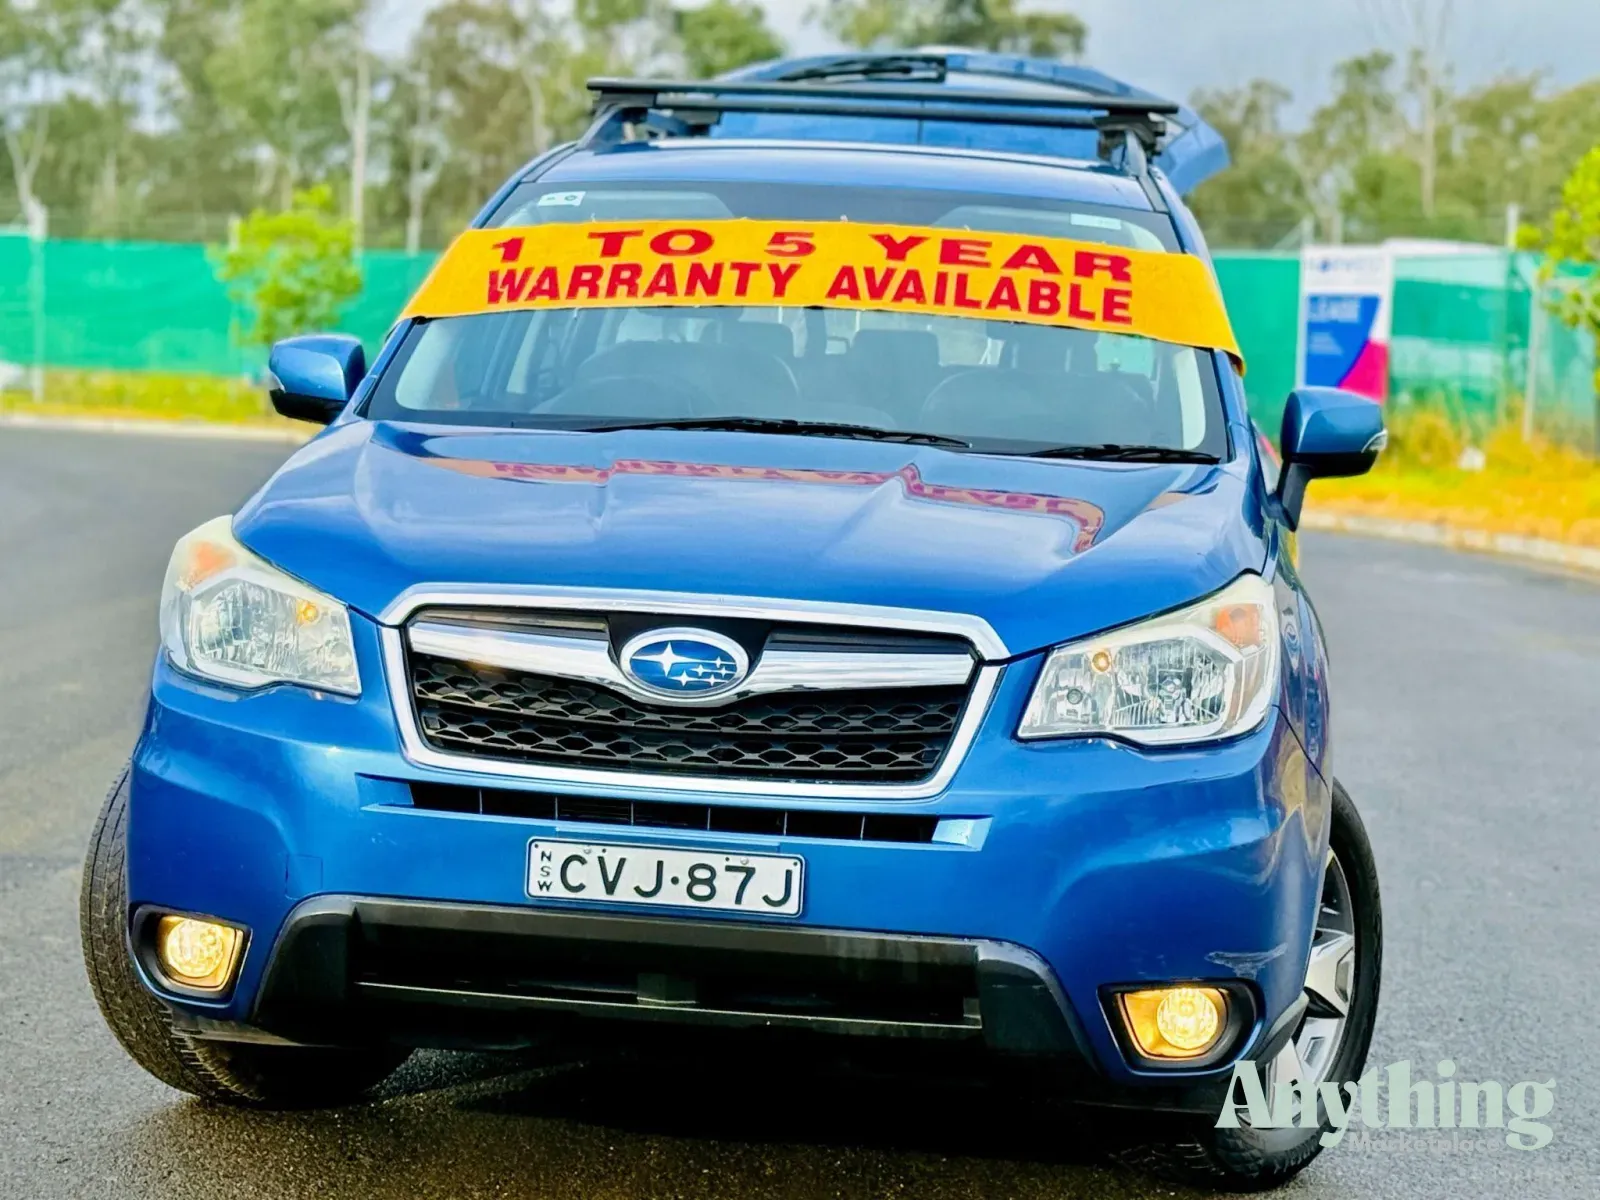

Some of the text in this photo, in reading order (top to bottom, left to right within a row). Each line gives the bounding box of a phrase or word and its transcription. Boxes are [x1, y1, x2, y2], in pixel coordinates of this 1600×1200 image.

[492, 229, 1132, 283] 1 TO 5 YEAR
[487, 262, 1133, 325] WARRANTY AVAILABLE
[537, 851, 553, 892] NSW
